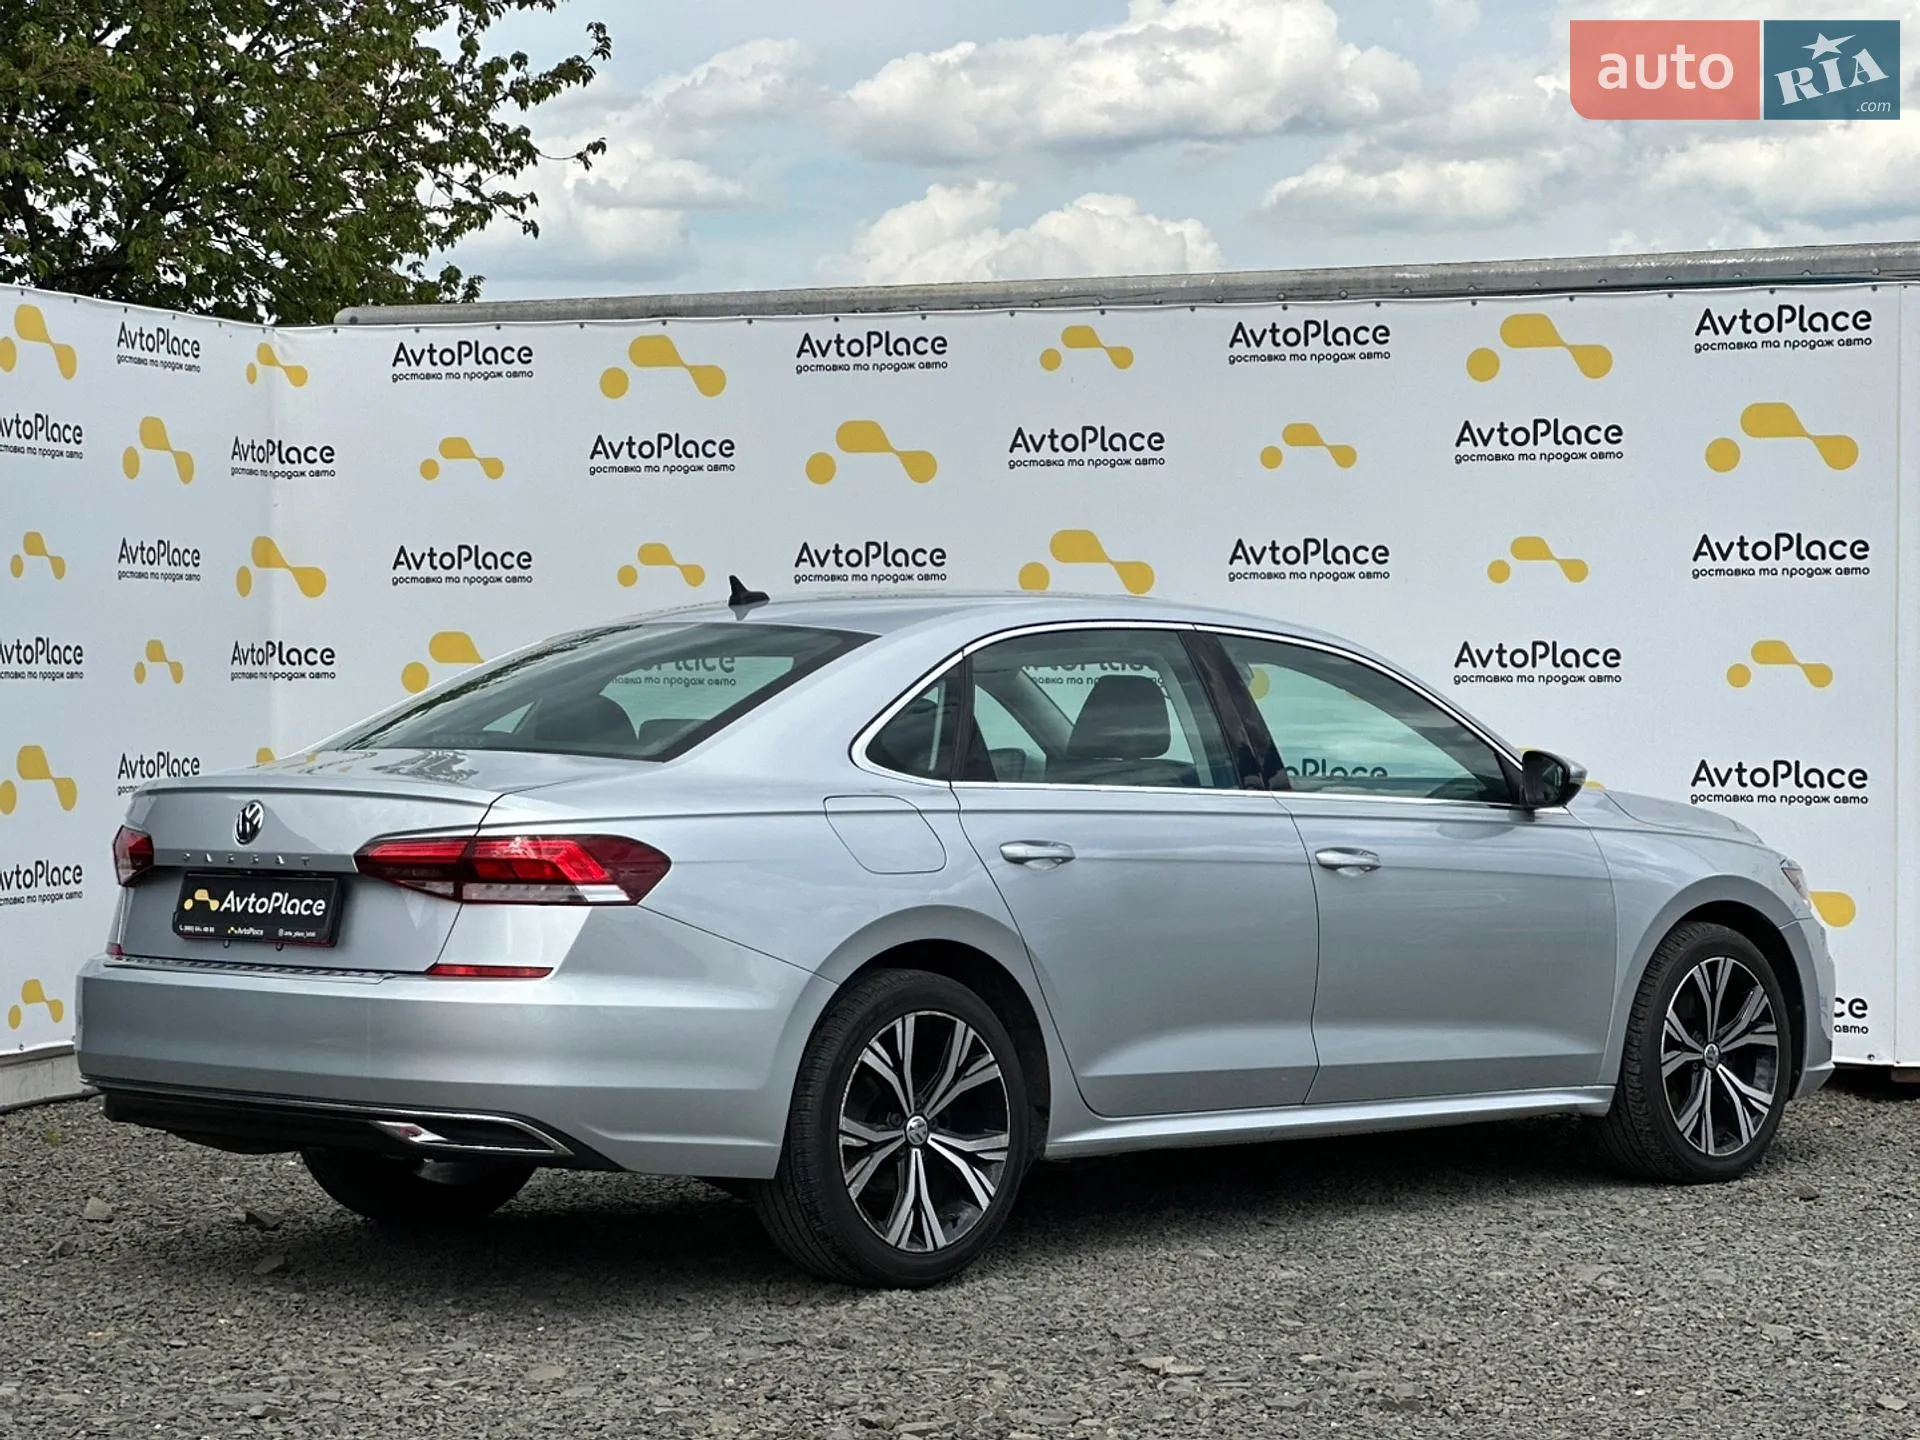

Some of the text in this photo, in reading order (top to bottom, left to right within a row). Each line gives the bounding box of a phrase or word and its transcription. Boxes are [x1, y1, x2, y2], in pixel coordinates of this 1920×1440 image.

[1695, 304, 1872, 336] AvtoPlace
[117, 321, 200, 359] AvtoPlace
[796, 330, 947, 359] AvtoPlace
[1229, 320, 1390, 348] AvtoPlace
[1694, 337, 1872, 354] доставка та продаж авто
[392, 340, 533, 367] AvtoPlace
[1228, 351, 1390, 365] доставка та продаж авто
[392, 372, 443, 383] доставка
[445, 372, 461, 380] та
[463, 371, 503, 381] продаж
[796, 361, 948, 375] доставка та продаж авто
[590, 433, 735, 460] AvtoPlace
[1009, 425, 1165, 454] AvtoPlace
[1455, 418, 1623, 448] AvtoPlace
[231, 436, 335, 465] AvtoPlace
[1008, 459, 1065, 470] доставка
[1087, 458, 1132, 469] продаж
[1135, 458, 1165, 466] авто
[1454, 451, 1624, 465] доставка та продаж авто
[589, 464, 735, 475] доставка та продаж авто
[118, 537, 200, 568] AvtoPlace
[392, 544, 532, 571] AvtoPlace
[795, 541, 946, 568] AvtoPlace
[1228, 538, 1390, 566] AvtoPlace
[1692, 532, 1870, 562] AvtoPlace
[392, 576, 442, 586] доставка
[445, 576, 460, 584] та
[463, 576, 503, 586] продаж
[794, 574, 849, 584] доставка
[871, 573, 914, 584] продаж
[917, 573, 947, 581] авто
[1228, 572, 1286, 581] доставка
[1310, 572, 1355, 581] продаж
[1358, 571, 1390, 579] авто
[1692, 567, 1870, 579] доставка та продаж авто
[231, 640, 335, 666] AvtoPlace
[1454, 640, 1621, 669] AvtoPlace
[1453, 675, 1622, 685] доставка та продаж авто
[118, 751, 200, 779] AvtoPlace
[1691, 759, 1868, 789] AvtoPlace
[1690, 794, 1869, 806] доставка та продаж авто
[219, 890, 326, 916] AvtoPlace
[1833, 1025, 1869, 1034] авто
